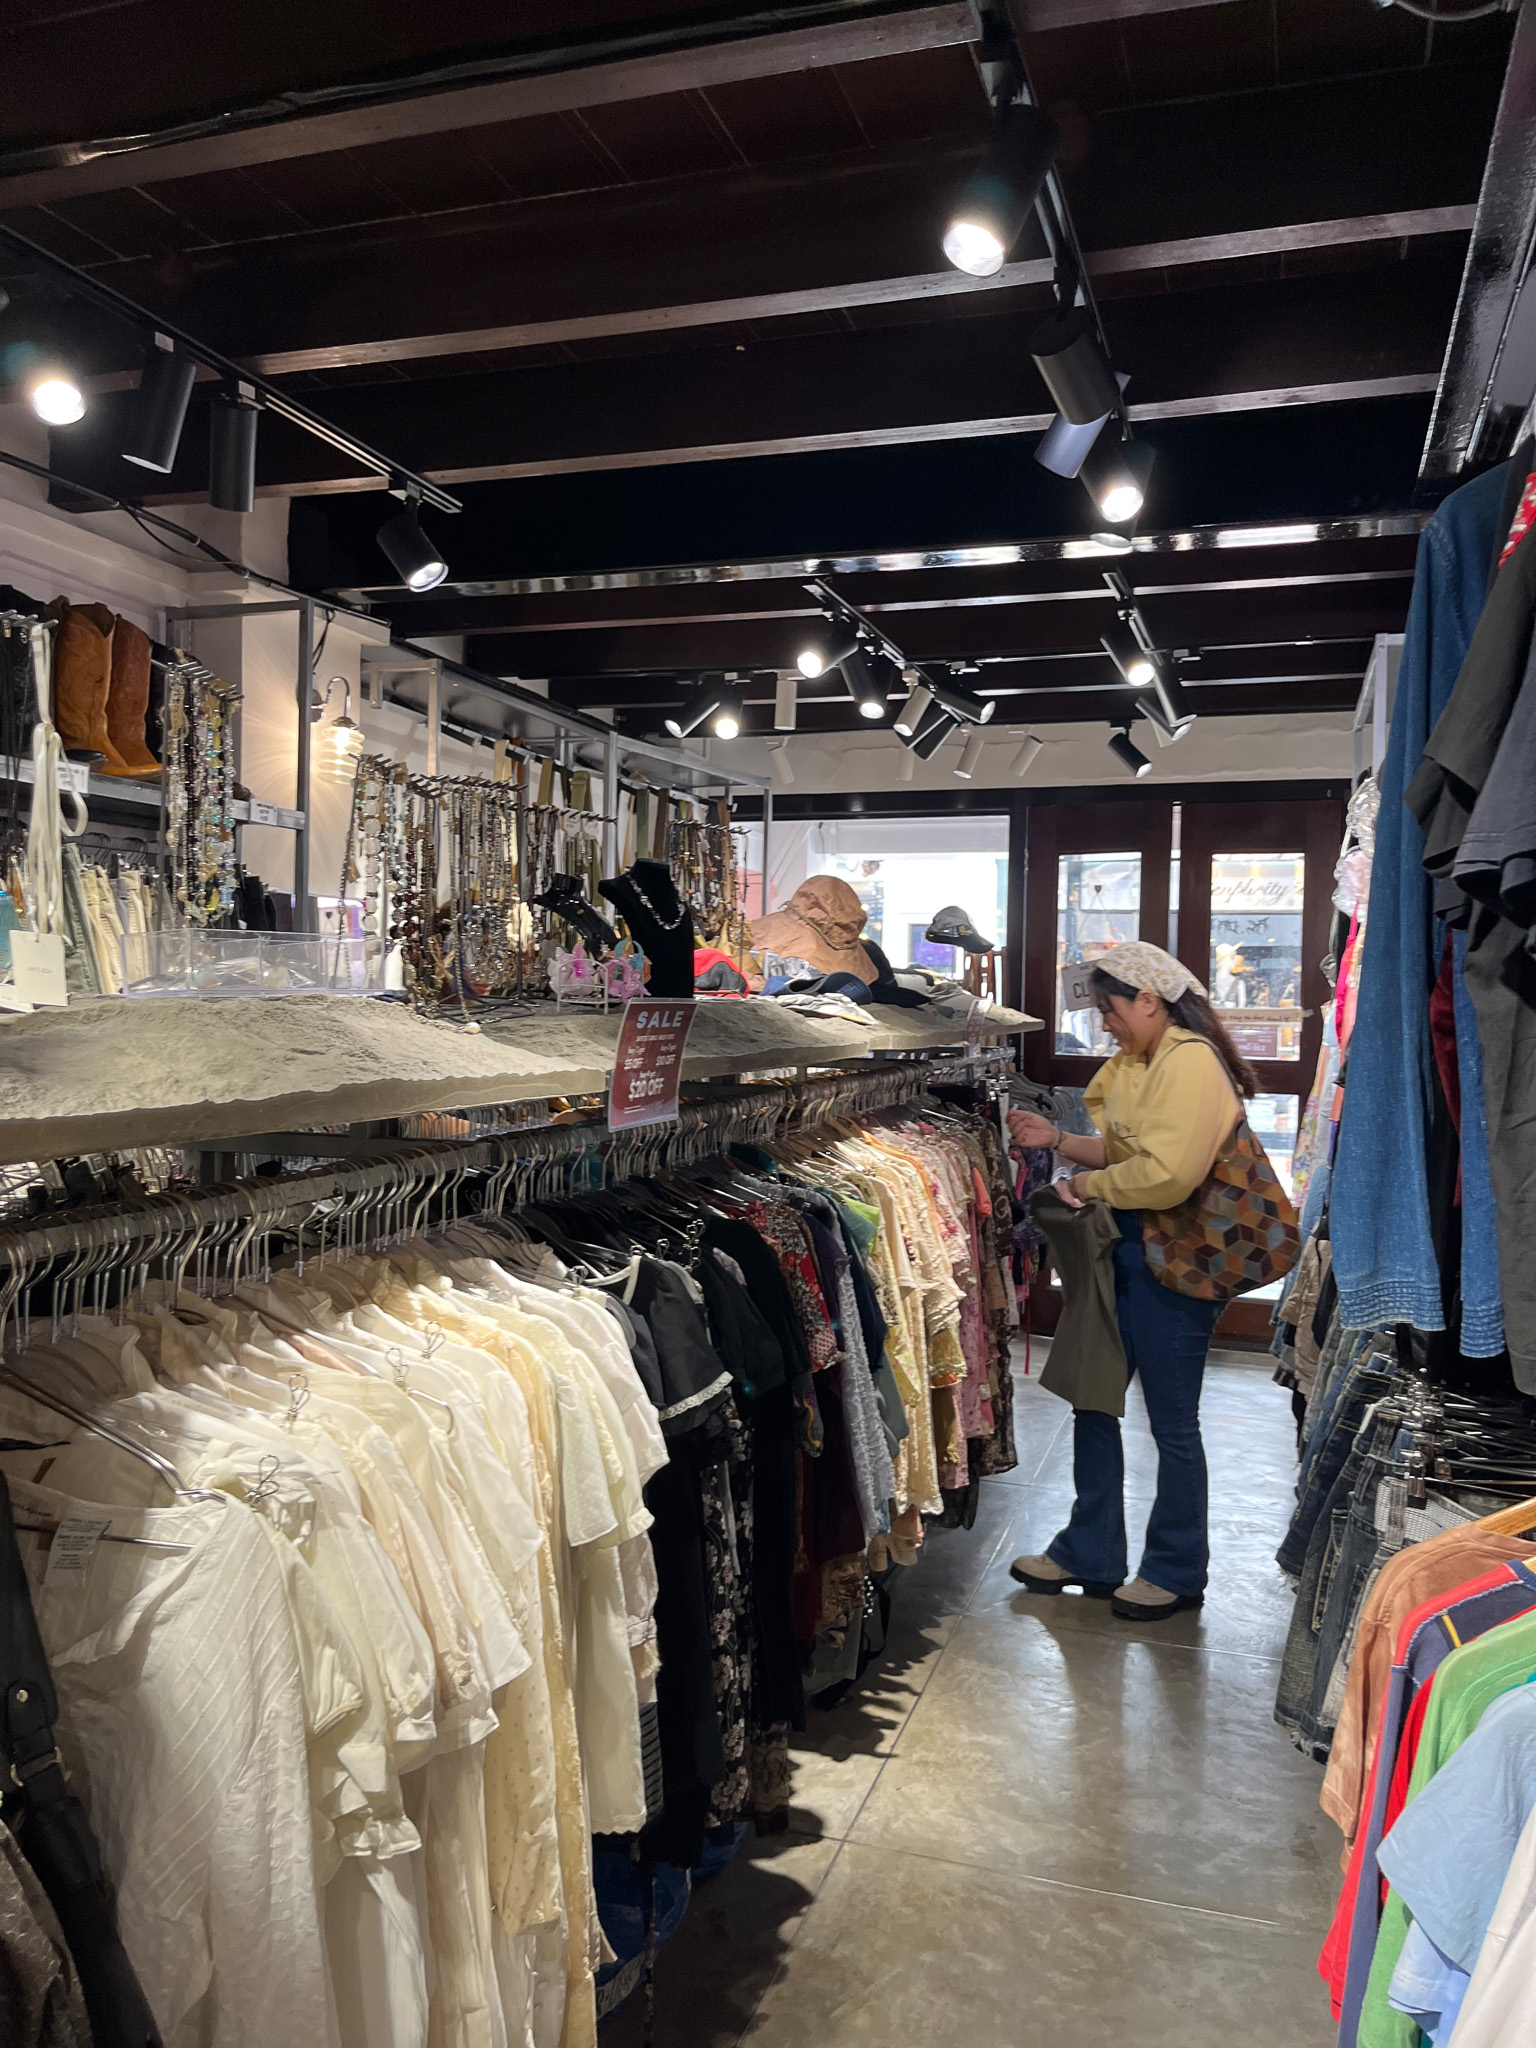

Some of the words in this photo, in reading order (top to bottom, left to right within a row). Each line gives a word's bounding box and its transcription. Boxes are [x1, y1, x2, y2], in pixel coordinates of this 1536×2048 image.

[636, 1011, 685, 1029] SALE
[632, 1058, 644, 1069] OFF
[665, 1055, 676, 1065] OFF
[628, 1079, 647, 1101] $20
[647, 1078, 665, 1096] OFF
